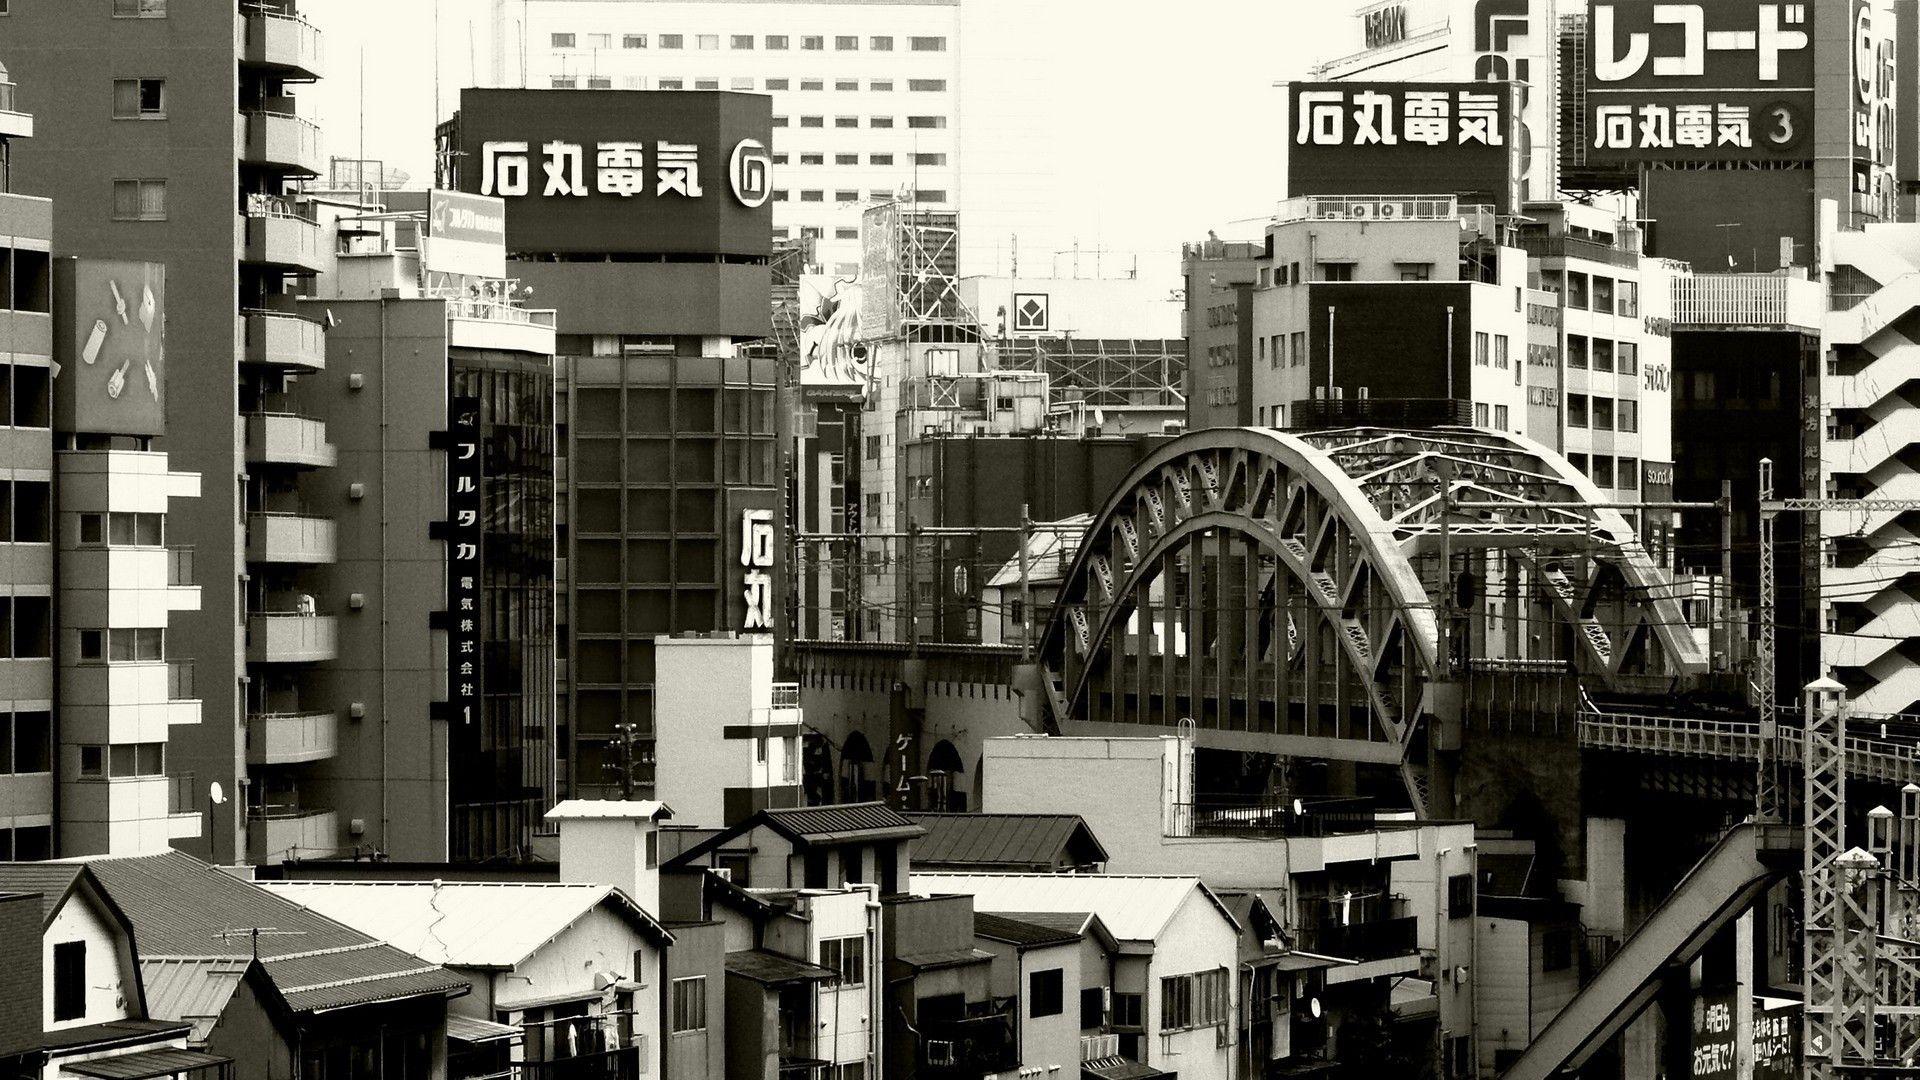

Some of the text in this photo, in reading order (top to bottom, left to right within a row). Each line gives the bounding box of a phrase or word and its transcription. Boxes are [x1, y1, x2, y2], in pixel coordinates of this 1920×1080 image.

[1595, 4, 1809, 81] レコード
[1296, 90, 1504, 146] 石丸電気
[1594, 103, 1795, 149] 石丸電気 3
[480, 140, 703, 197] 石丸電気
[741, 508, 774, 629] 石丸
